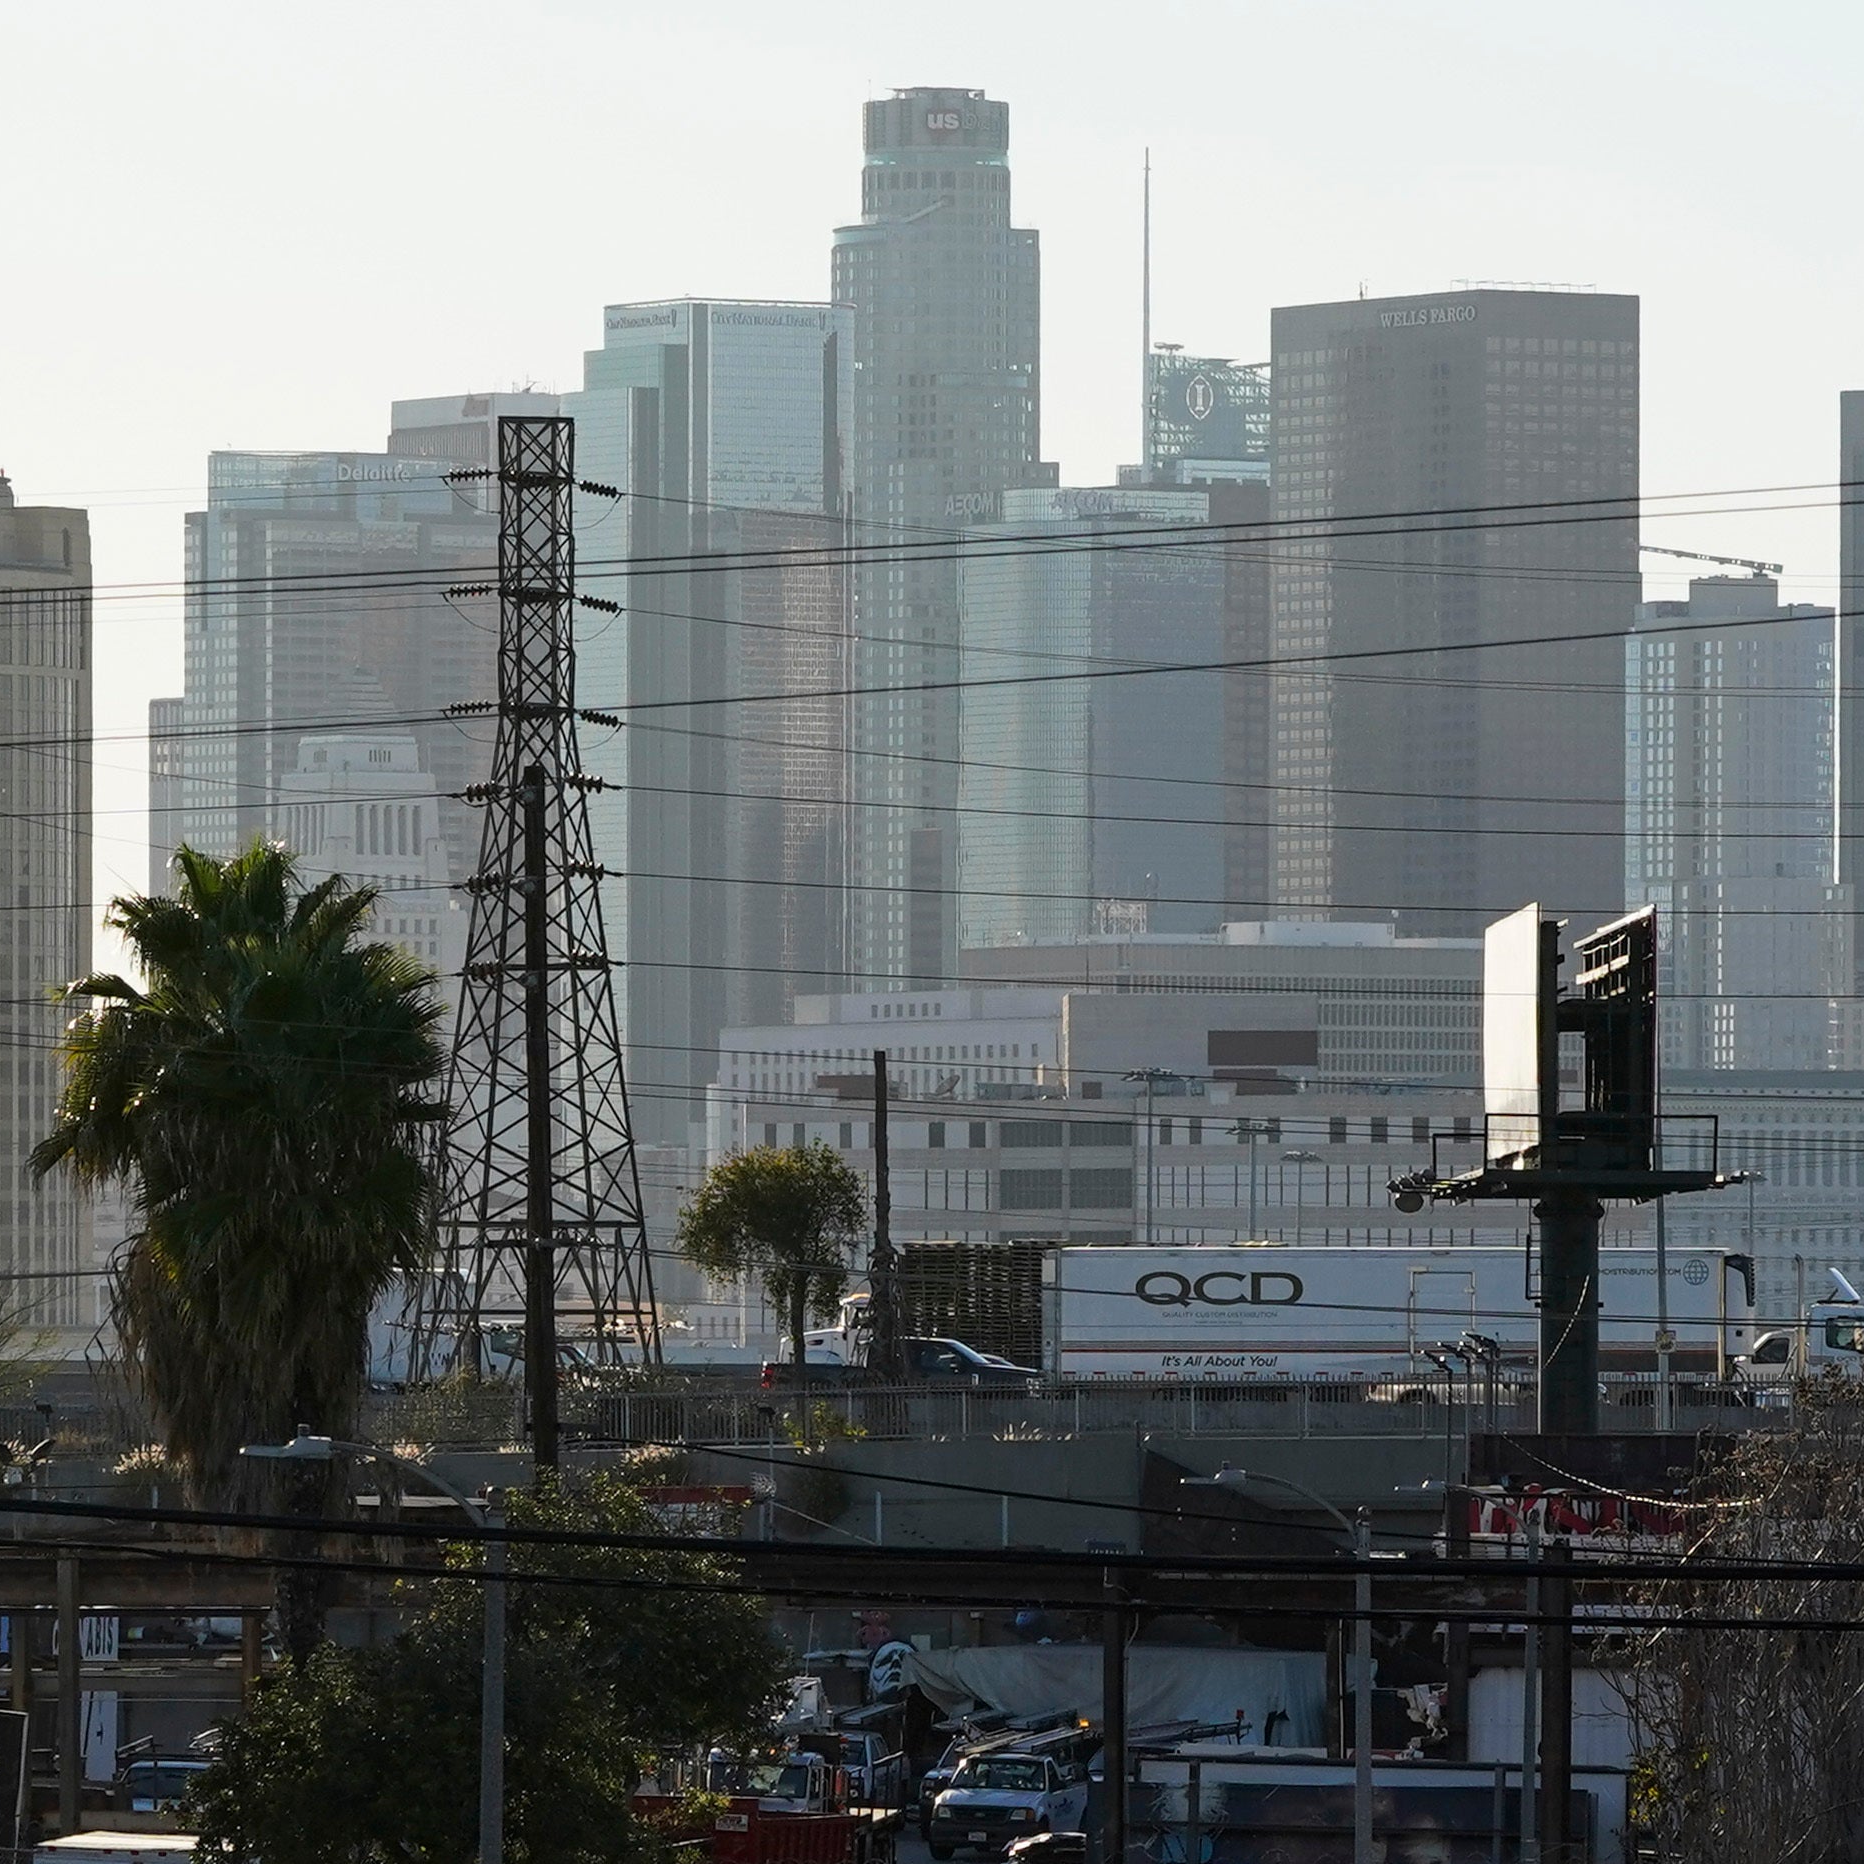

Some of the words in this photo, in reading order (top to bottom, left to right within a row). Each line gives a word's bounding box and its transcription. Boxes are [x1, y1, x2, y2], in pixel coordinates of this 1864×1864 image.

[1381, 310, 1427, 328] WELLS
[1429, 305, 1476, 324] FARGO
[337, 463, 410, 482] Deloitte
[944, 492, 994, 517] AECOM
[1135, 1271, 1304, 1308] QCD
[1162, 1311, 1193, 1319] QUALITY
[1161, 1355, 1181, 1367] It's
[1184, 1355, 1202, 1367] All
[1204, 1355, 1246, 1367] About
[1250, 1355, 1278, 1367] You!
